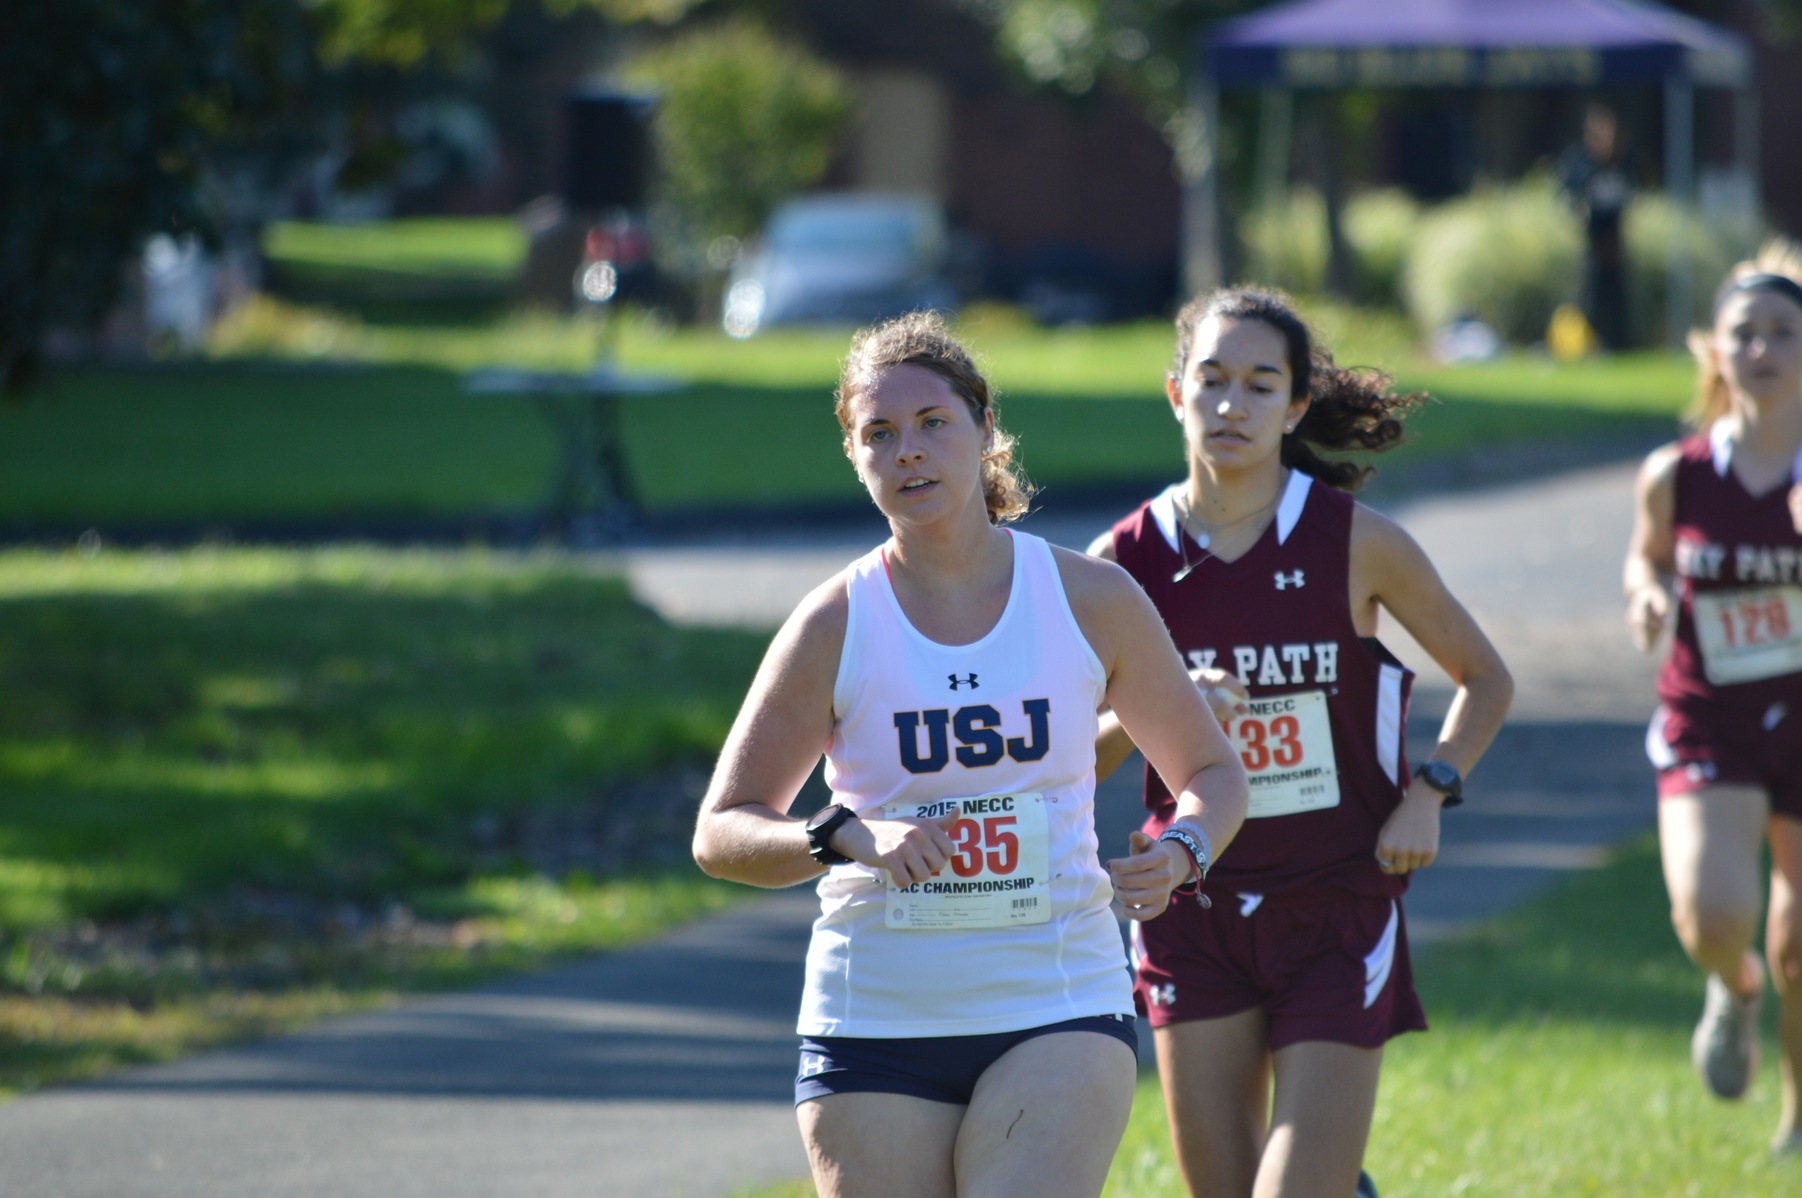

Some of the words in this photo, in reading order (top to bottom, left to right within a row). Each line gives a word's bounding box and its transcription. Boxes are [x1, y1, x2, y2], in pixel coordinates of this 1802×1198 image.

[1234, 641, 1339, 686] PATH
[1249, 700, 1296, 716] NECC
[893, 698, 1051, 775] USJ
[916, 801, 957, 818] 2015
[963, 797, 1014, 815] NECC
[930, 815, 1019, 878] 35
[924, 877, 1035, 894] CHAMPIONSHIP
